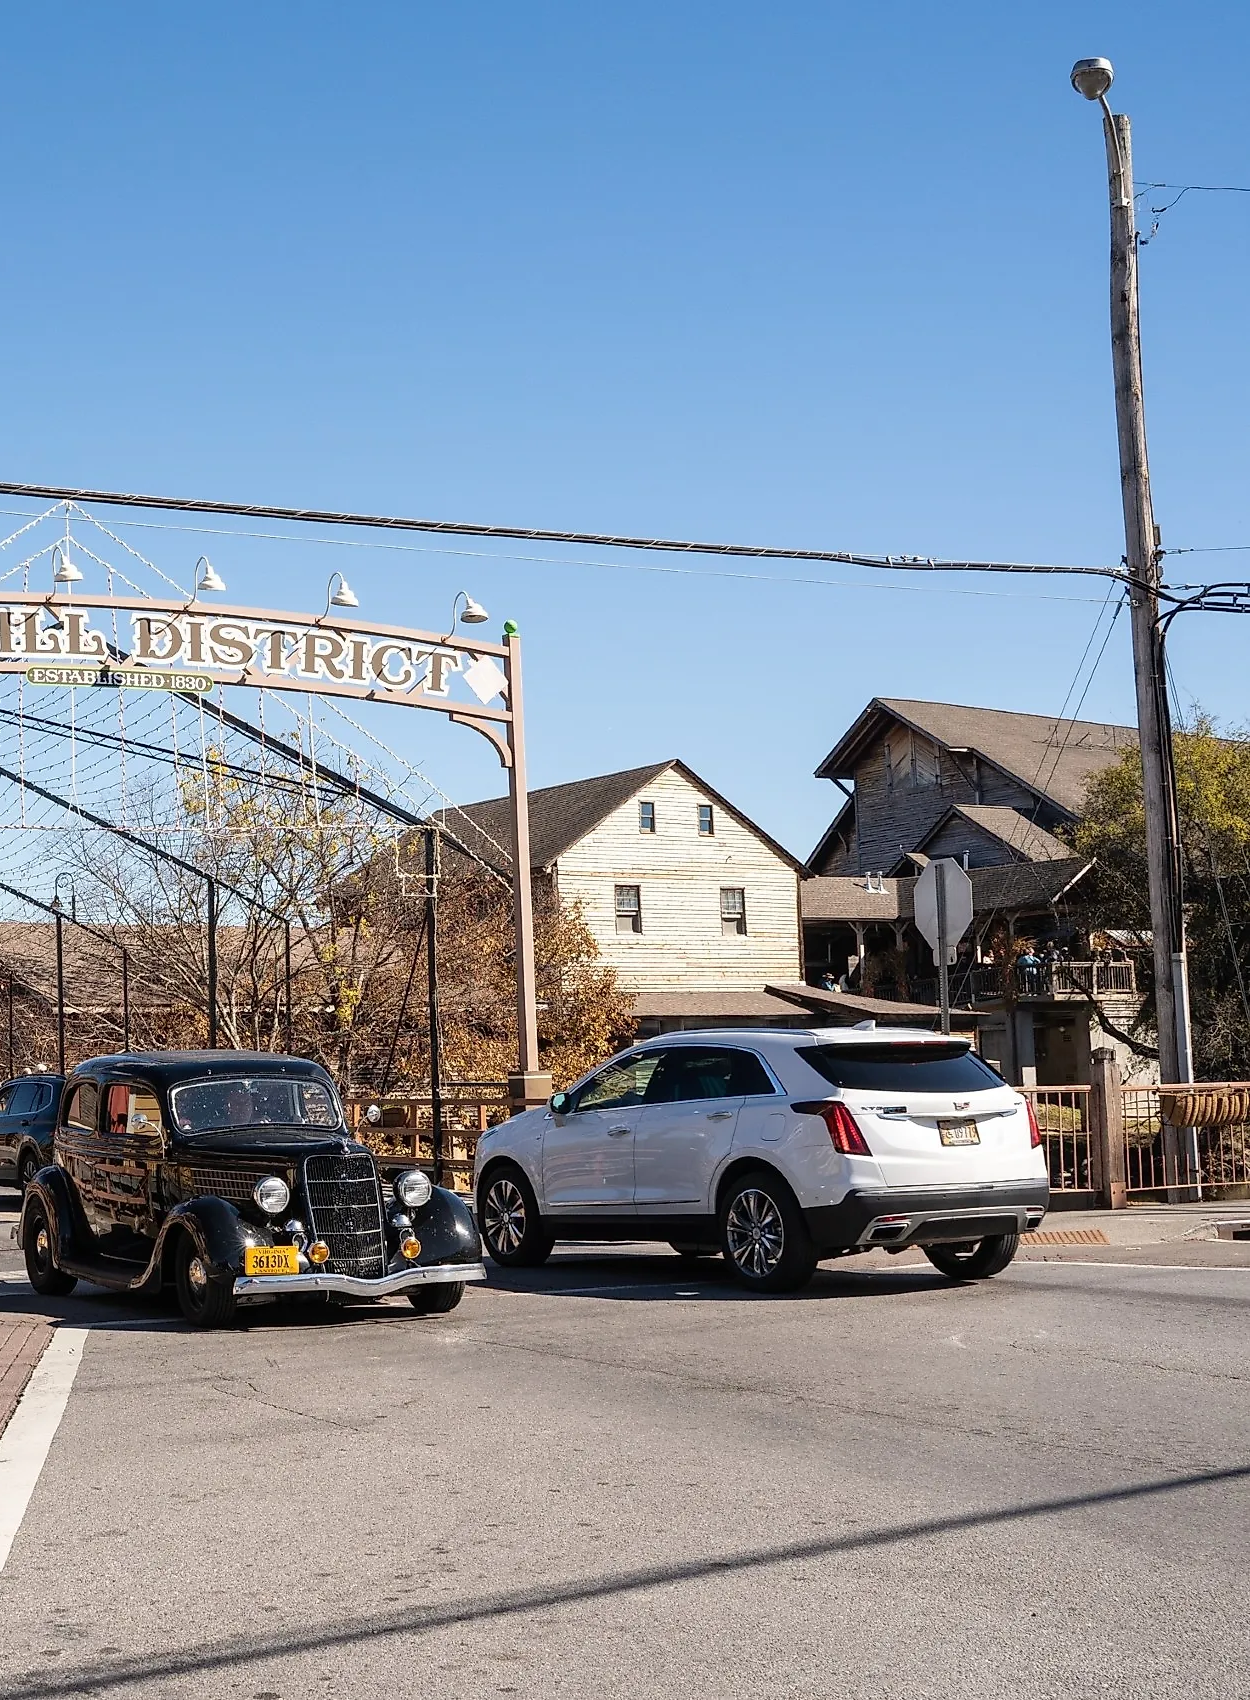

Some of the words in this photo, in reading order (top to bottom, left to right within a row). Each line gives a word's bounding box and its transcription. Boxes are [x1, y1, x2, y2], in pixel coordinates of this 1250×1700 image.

[133, 614, 459, 695] DISTRICT
[32, 668, 165, 688] ESTABLISHED
[170, 675, 207, 690] 1830
[252, 1254, 290, 1268] 3613DX
